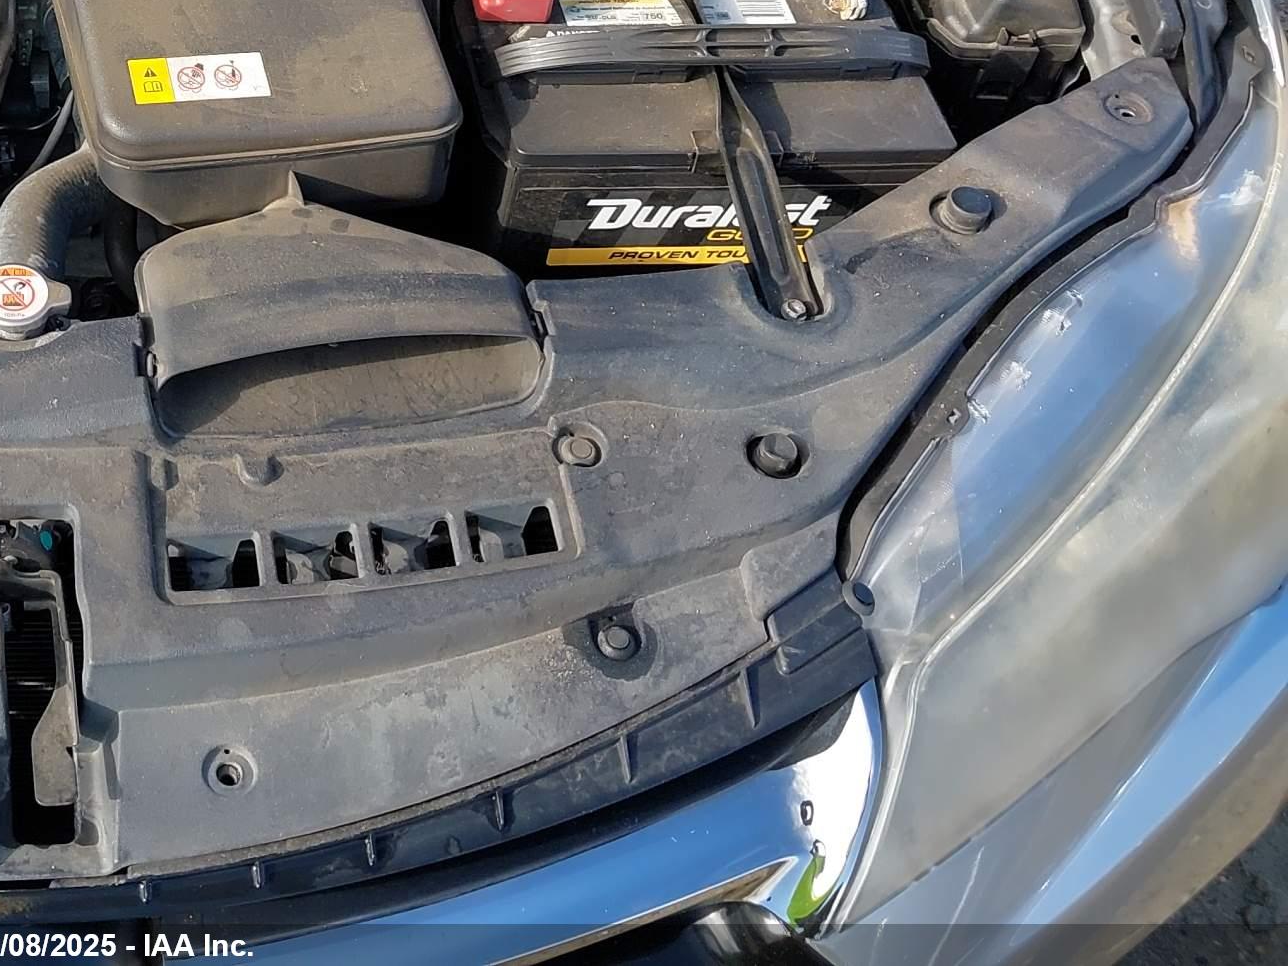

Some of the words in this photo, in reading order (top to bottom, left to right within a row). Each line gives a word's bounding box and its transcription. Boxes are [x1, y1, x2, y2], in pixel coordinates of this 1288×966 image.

[586, 195, 831, 230] Duralst
[608, 250, 699, 260] PROVEN
[706, 250, 747, 259] TOU
